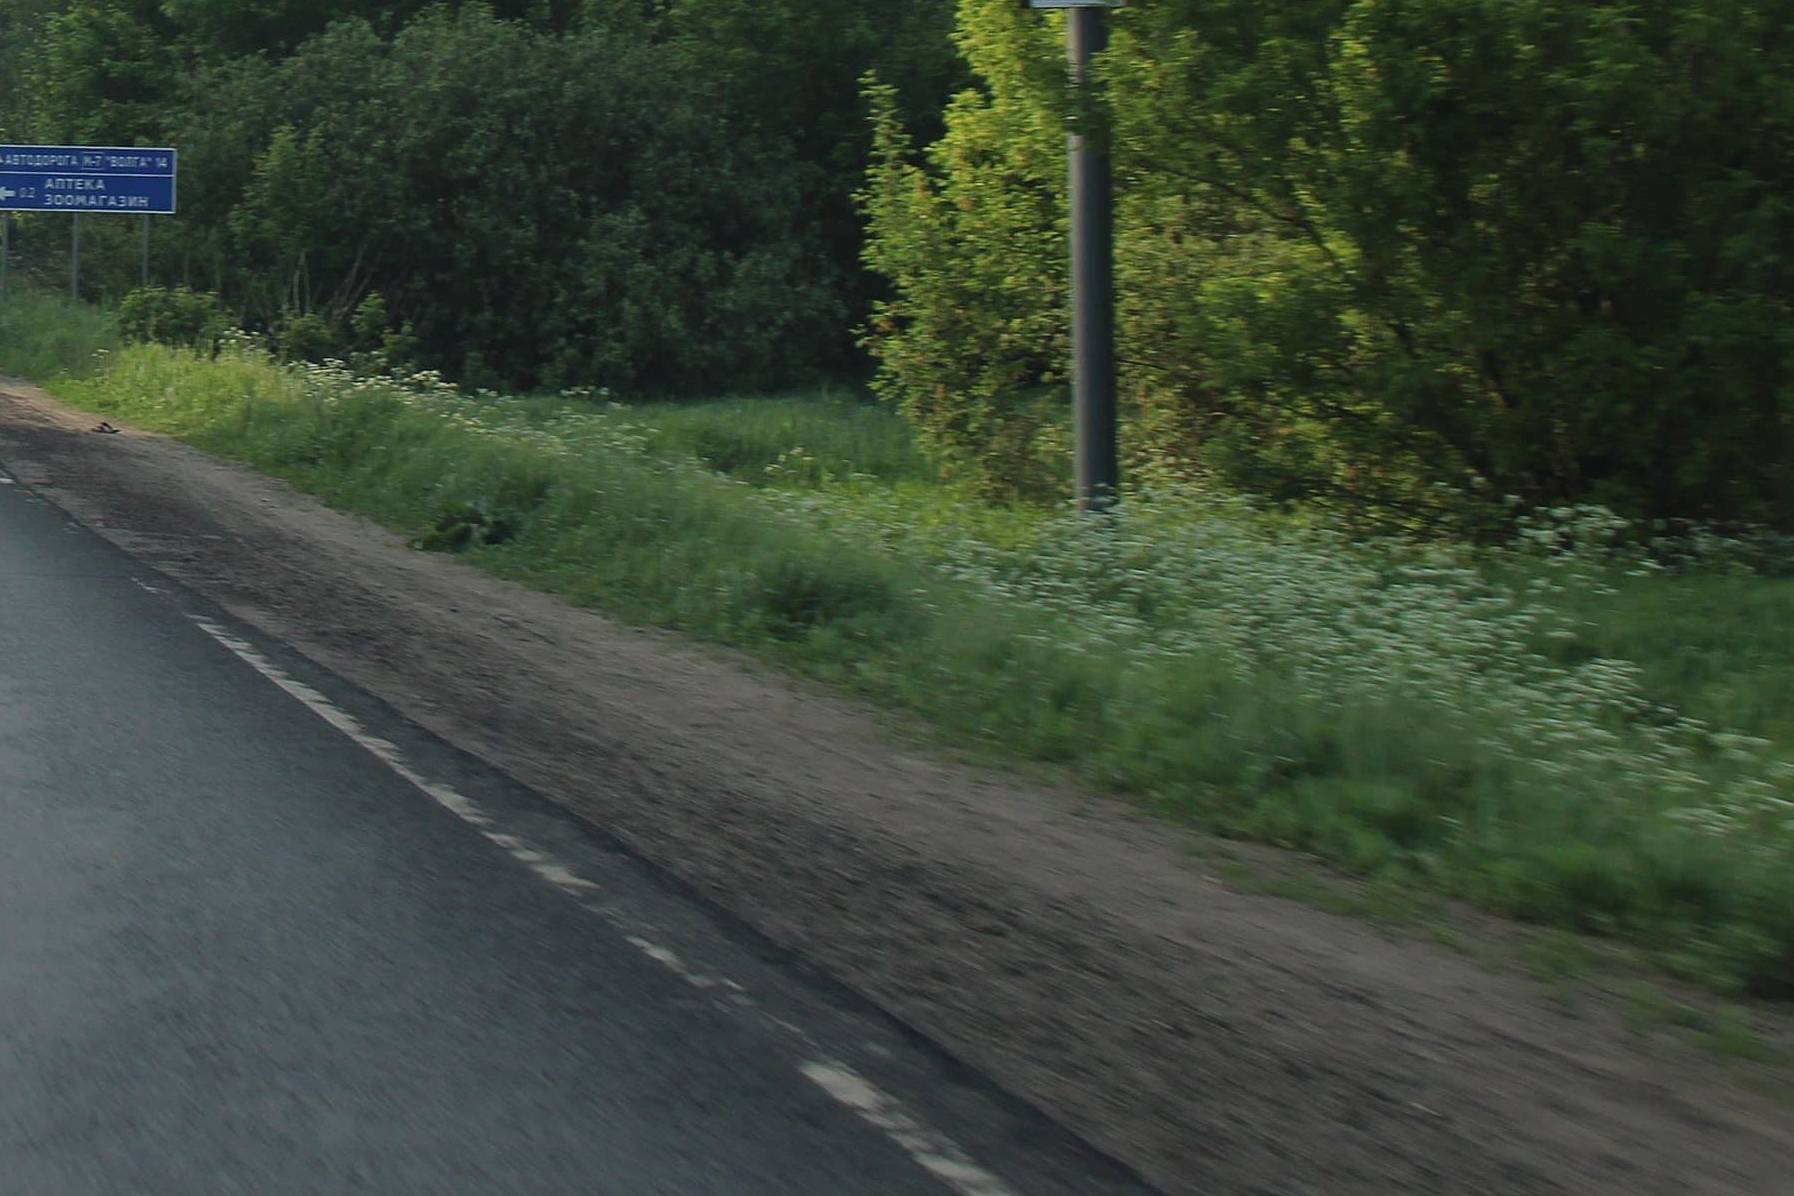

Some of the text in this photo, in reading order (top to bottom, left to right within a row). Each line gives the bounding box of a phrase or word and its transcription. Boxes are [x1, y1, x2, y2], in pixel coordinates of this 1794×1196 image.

[5, 154, 78, 167] АВТОДОРОГА
[44, 177, 106, 190] АПТЕКА
[43, 194, 150, 208] ЗООМАГАЗИН
